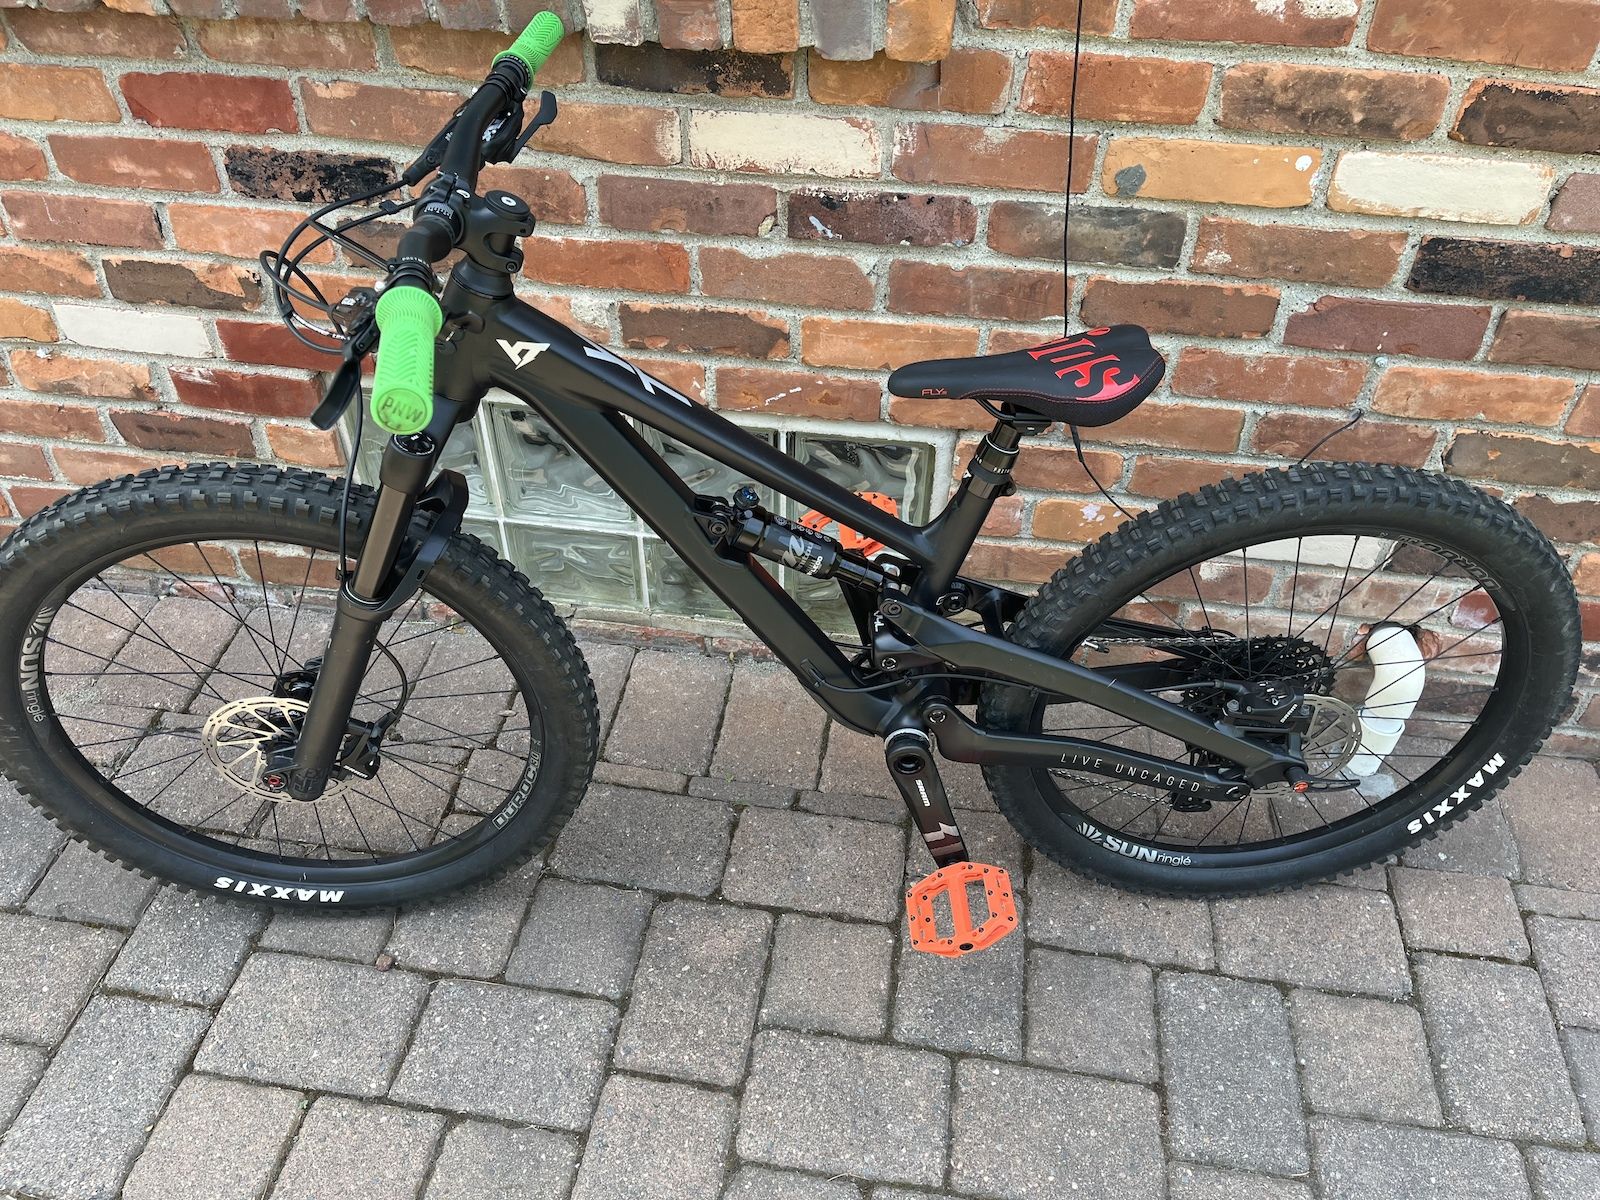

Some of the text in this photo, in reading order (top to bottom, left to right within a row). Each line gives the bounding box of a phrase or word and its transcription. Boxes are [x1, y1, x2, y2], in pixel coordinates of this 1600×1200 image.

[382, 395, 424, 423] PNW
[20, 636, 44, 691] SUN
[1060, 752, 1201, 793] LIVE UNCAGED
[915, 779, 931, 807] SRAM
[1406, 752, 1506, 835] MAXXIS
[1102, 834, 1192, 867] SUN ringlé
[213, 876, 345, 903] MAXXIS
